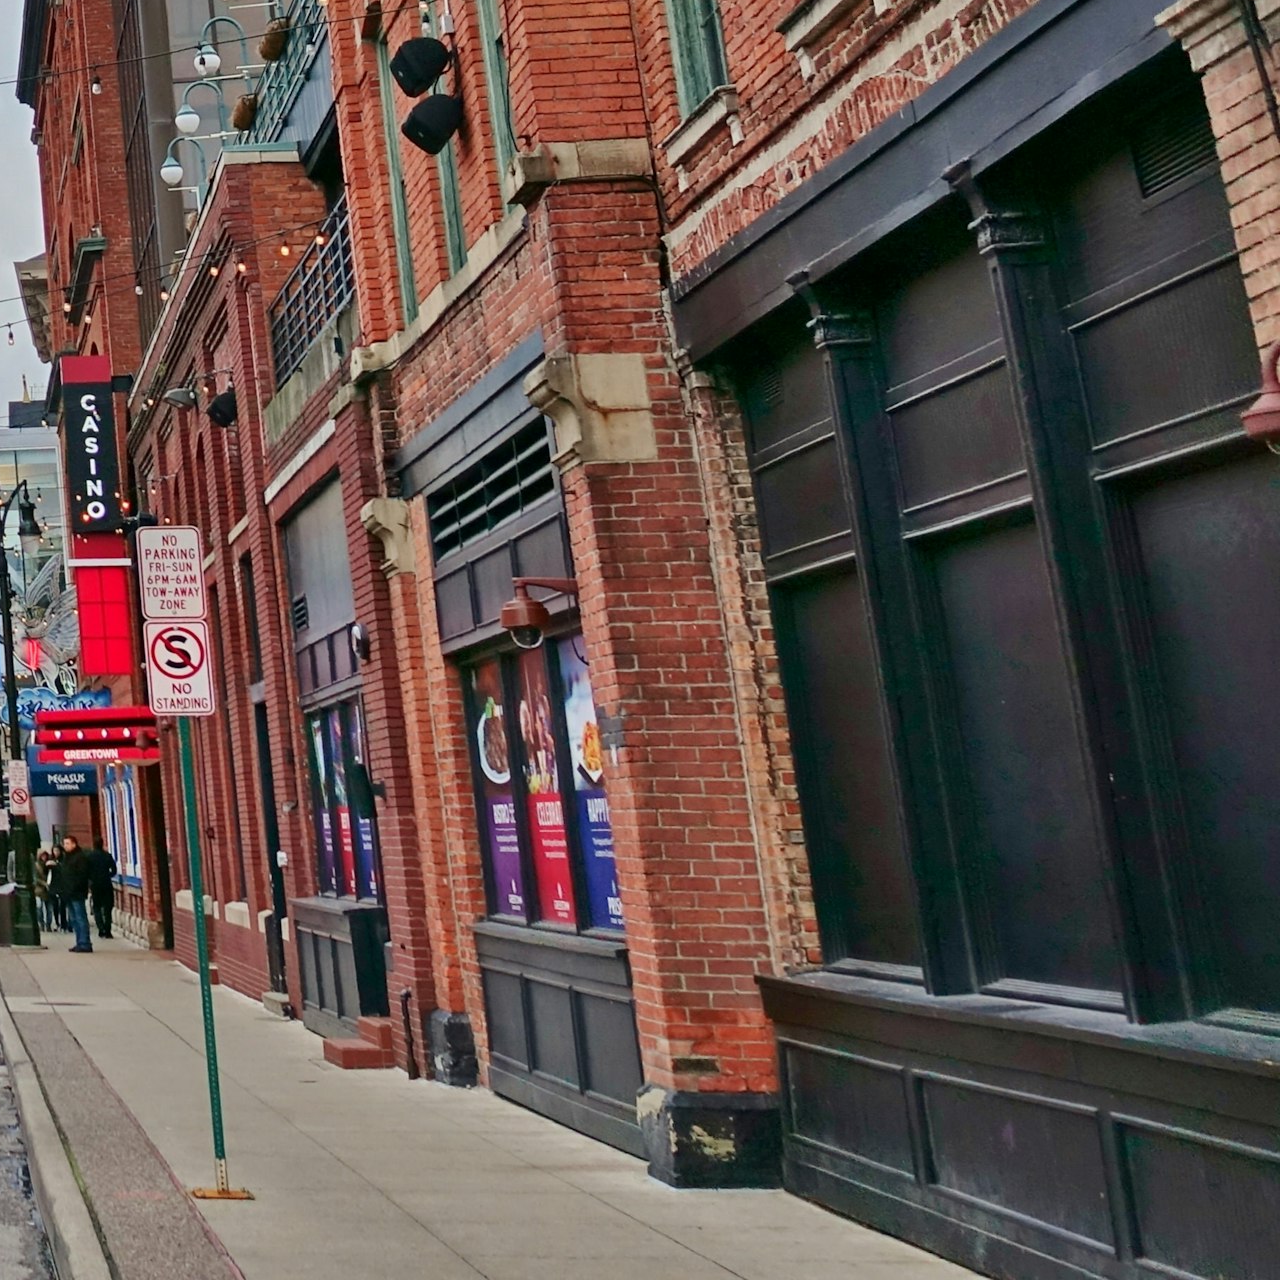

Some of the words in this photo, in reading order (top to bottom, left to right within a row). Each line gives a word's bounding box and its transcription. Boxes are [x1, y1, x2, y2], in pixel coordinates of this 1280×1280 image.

[80, 394, 106, 519] CASINO
[162, 535, 177, 547] NO
[145, 548, 196, 560] PARKING
[149, 562, 193, 572] FRI-SUN
[147, 574, 197, 585] 6PM-6AM
[145, 586, 200, 597] TOW-AWAY
[159, 599, 187, 610] ZONE
[172, 682, 192, 695] NO
[156, 697, 209, 710] STANDING
[63, 748, 119, 760] GREEKTOWN
[47, 773, 86, 785] PEGASUS
